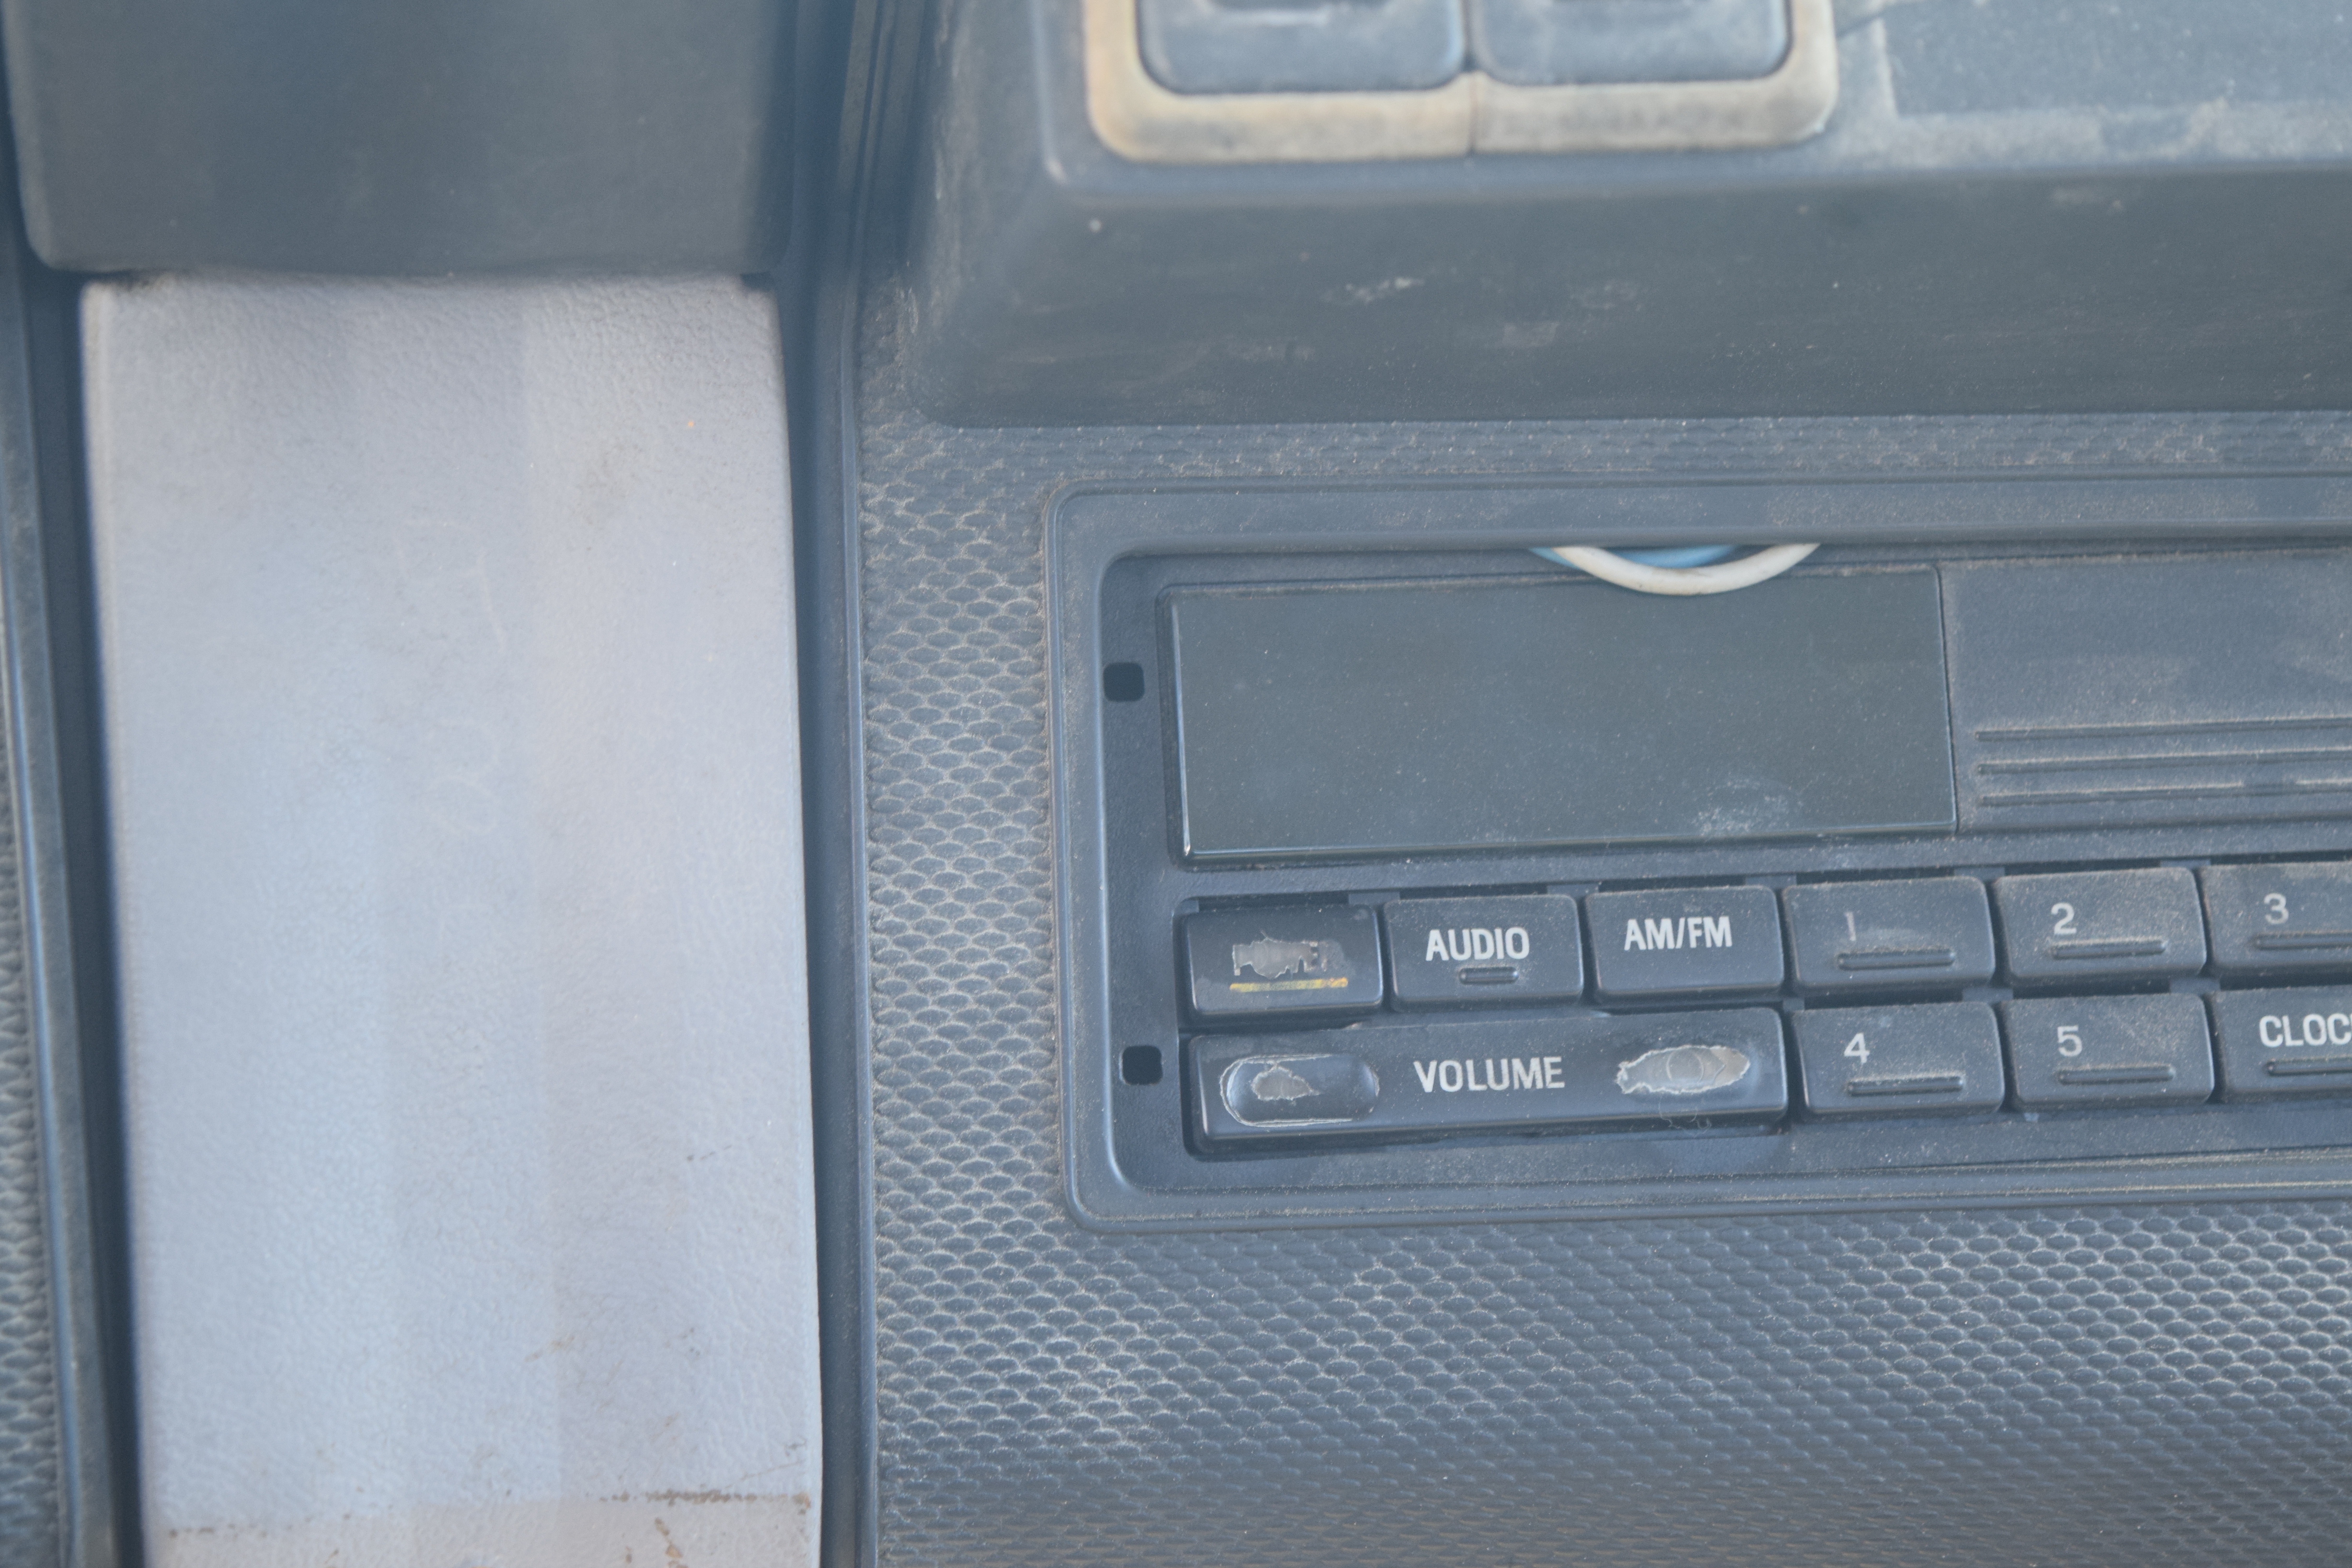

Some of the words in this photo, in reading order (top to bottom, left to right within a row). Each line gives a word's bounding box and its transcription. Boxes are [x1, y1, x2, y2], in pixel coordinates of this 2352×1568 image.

[2051, 903, 2076, 935] 2
[2263, 893, 2289, 925] 3
[1425, 927, 1530, 962] AUDIO
[1624, 916, 1733, 951] AM/FM
[2057, 1025, 2082, 1057] 5
[2259, 1013, 2352, 1048] CLOC
[1844, 1033, 1870, 1063] 4
[1414, 1057, 1565, 1093] VOLUME
